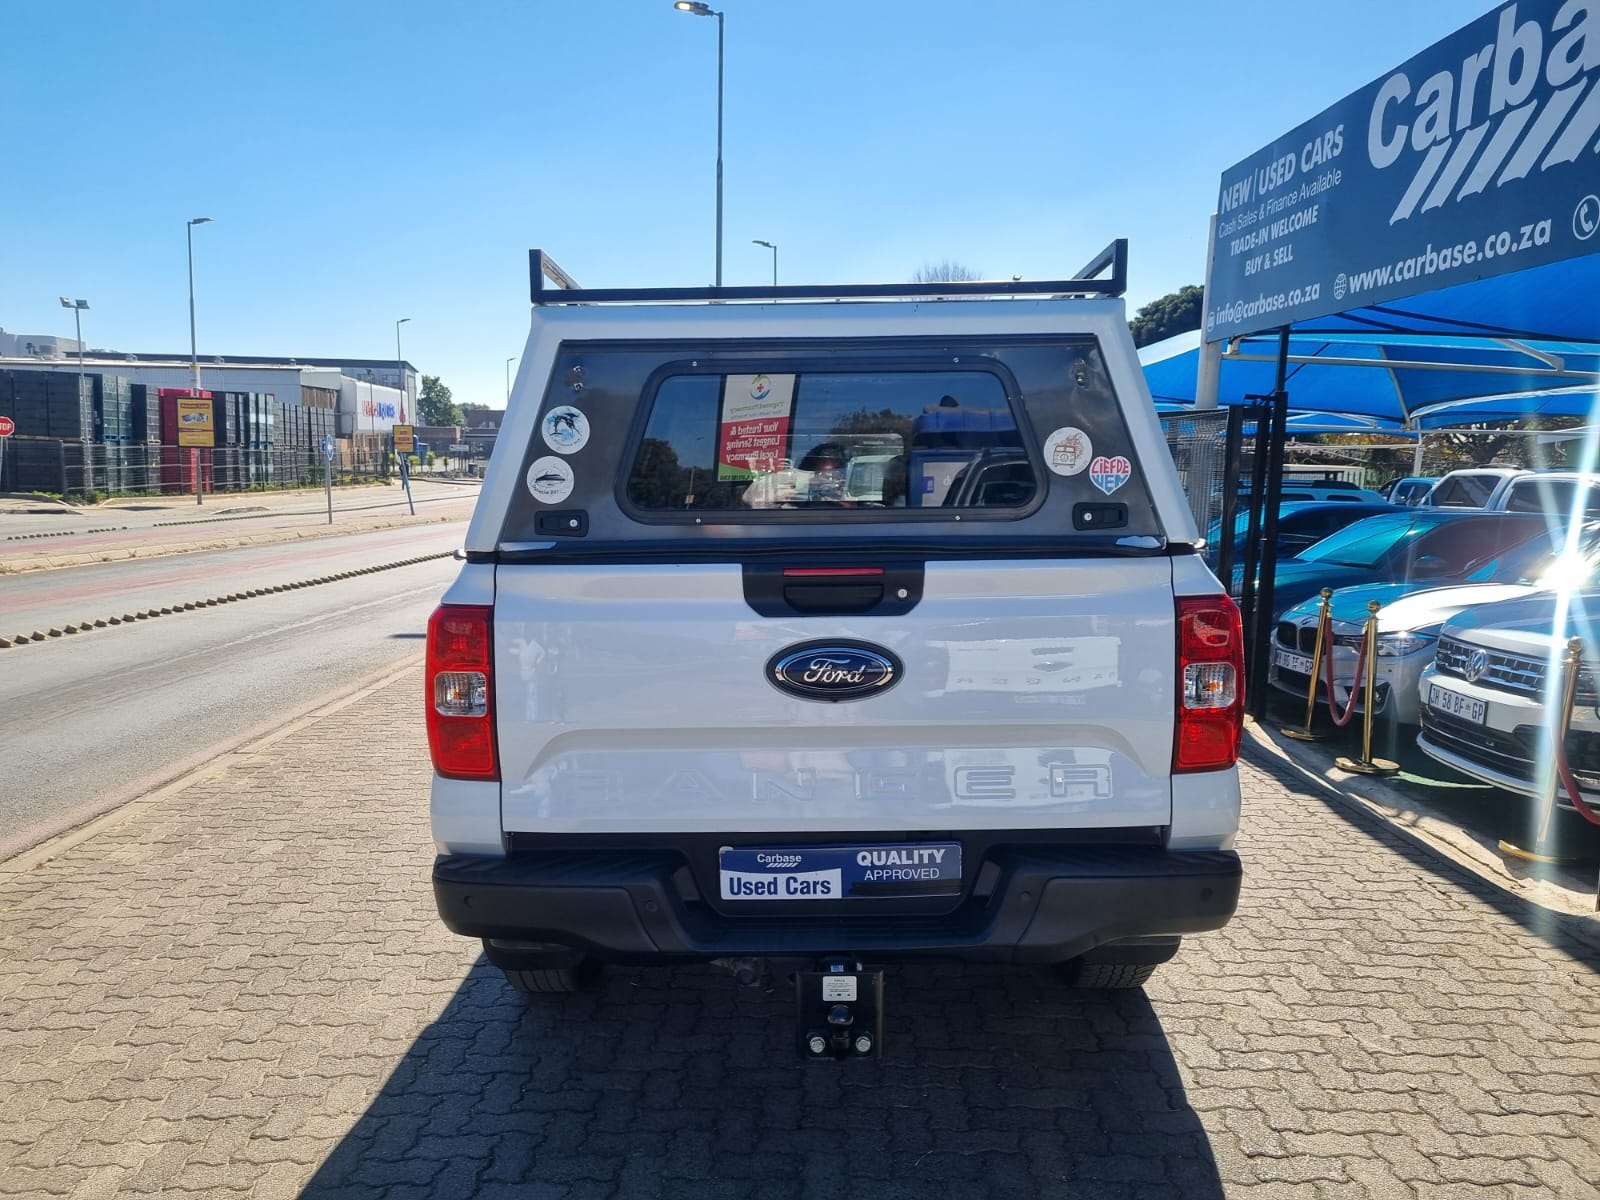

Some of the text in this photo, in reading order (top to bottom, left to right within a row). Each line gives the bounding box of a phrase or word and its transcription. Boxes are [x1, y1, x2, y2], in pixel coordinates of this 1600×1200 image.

[1220, 124, 1344, 215] NEW USED CARS
[1219, 167, 1342, 239] Cash Sales & Finance Available
[1230, 204, 1319, 257] TRADE-IN WELCOME
[1245, 244, 1294, 276] BUY & SELL
[1349, 217, 1552, 295] www.carbase.co.za
[1216, 283, 1320, 326] info@carbase.co.za
[803, 658, 866, 683] Ford
[1442, 691, 1452, 710] 58
[1454, 695, 1465, 715] BF
[1472, 701, 1485, 721] GP
[576, 762, 1113, 803] RANGER
[757, 853, 802, 864] Carbase
[857, 848, 945, 867] QUALITY
[729, 876, 831, 896] Used Cars
[864, 868, 940, 881] APPROVED
